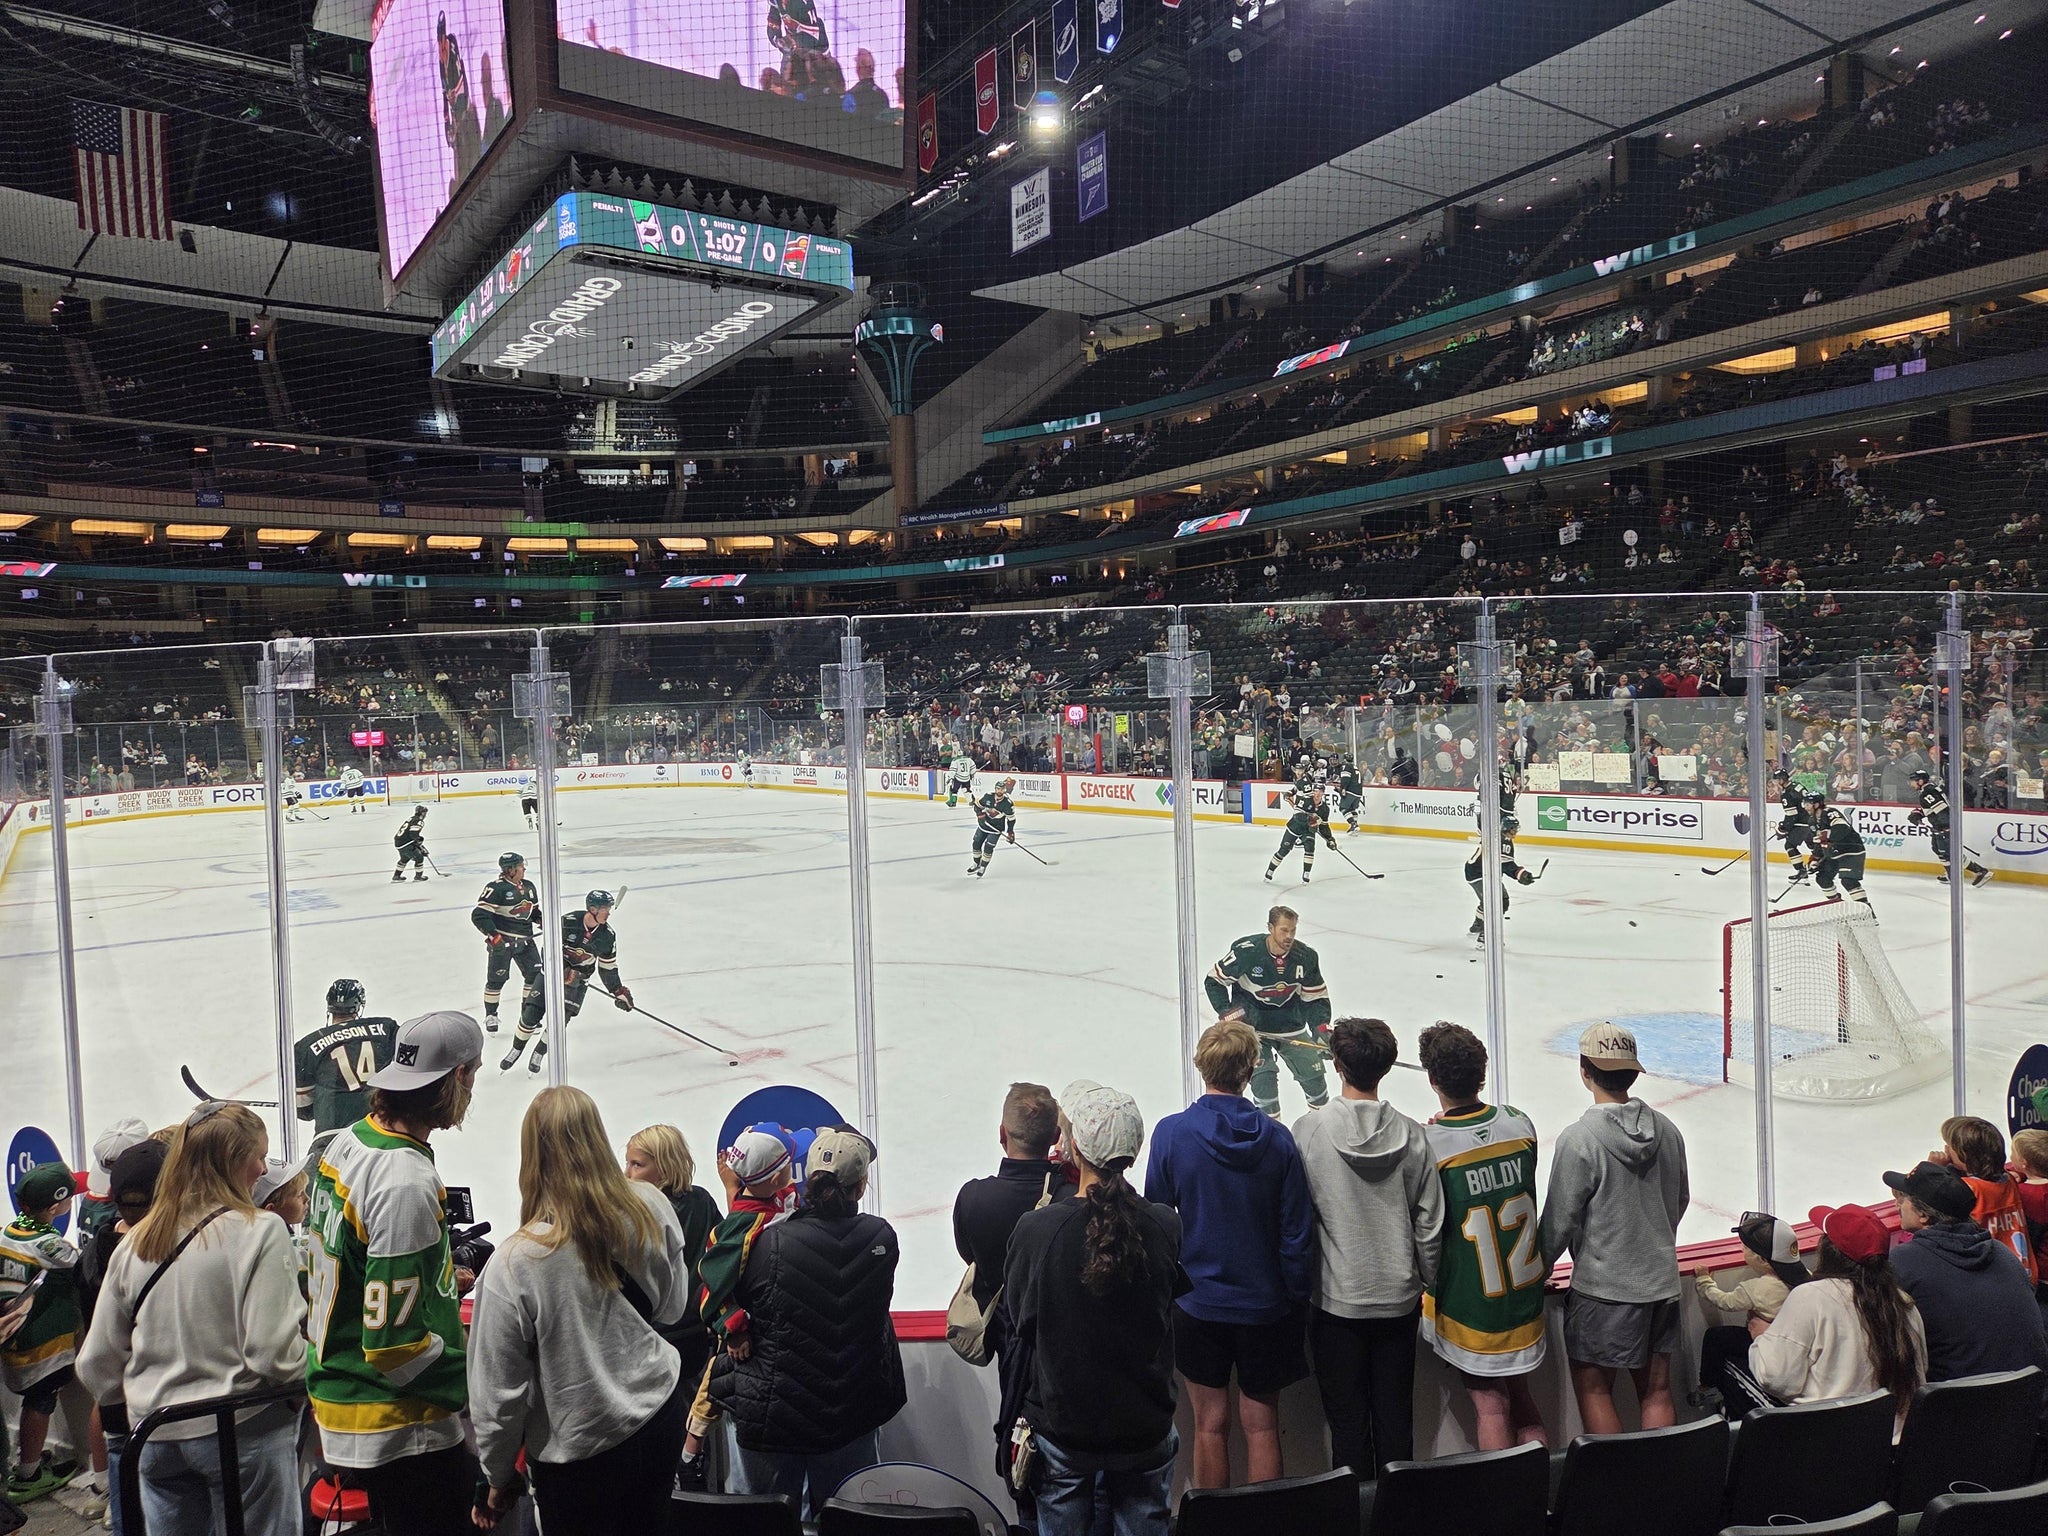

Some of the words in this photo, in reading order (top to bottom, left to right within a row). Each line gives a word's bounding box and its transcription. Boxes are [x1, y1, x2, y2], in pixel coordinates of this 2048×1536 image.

[592, 202, 624, 213] PENALTY
[1015, 193, 1045, 219] MINNESOTA
[713, 220, 736, 231] SHOTS
[671, 225, 686, 246] 0
[704, 229, 747, 254] 1:07
[707, 250, 744, 264] PRE-GAME
[762, 242, 777, 262] 0
[816, 244, 842, 255] PENALTY
[1593, 231, 1696, 277] WILD
[499, 271, 505, 294] 0
[550, 277, 622, 323] GRAND
[470, 302, 476, 323] 0
[629, 354, 693, 382] GRAND
[694, 302, 774, 344] CASINO
[494, 334, 555, 367] CASINO
[1042, 411, 1101, 433] WILD
[1502, 436, 1612, 475] WILD
[920, 513, 938, 521] Wealth
[939, 509, 972, 520] Management
[972, 507, 983, 516] Club
[984, 505, 998, 514] Level
[944, 554, 1005, 572] WILD
[343, 573, 427, 588] WILD
[701, 768, 720, 777] BMO
[793, 767, 817, 778] LOFFLER
[960, 762, 968, 772] 31
[432, 777, 460, 788] UHC
[487, 777, 518, 786] GRAND
[890, 772, 907, 786] IUOE
[909, 773, 919, 787] 49
[118, 793, 141, 801] WOODY
[146, 791, 171, 799] WOODY
[178, 795, 203, 803] CREEK
[1080, 782, 1136, 802] SEATGEEK
[118, 800, 141, 808] CREEK
[147, 797, 171, 805] CREEK
[1400, 802, 1413, 813] The
[1415, 802, 1456, 816] Minnesota
[93, 808, 110, 816] YouTube
[1547, 805, 1698, 829] enterprise
[1858, 811, 1891, 823] PUT
[1997, 822, 2048, 844] CHS
[1879, 838, 1905, 848] ICE
[1295, 965, 1304, 979] A
[337, 995, 345, 1003] 14
[310, 1026, 368, 1056] ERIKSSON
[368, 1024, 386, 1036] EK
[1599, 1037, 1637, 1055] NASH
[330, 1041, 376, 1091] 14
[1465, 1158, 1523, 1196] BOLDY
[1462, 1193, 1545, 1297] 12
[363, 1277, 420, 1330] 97
